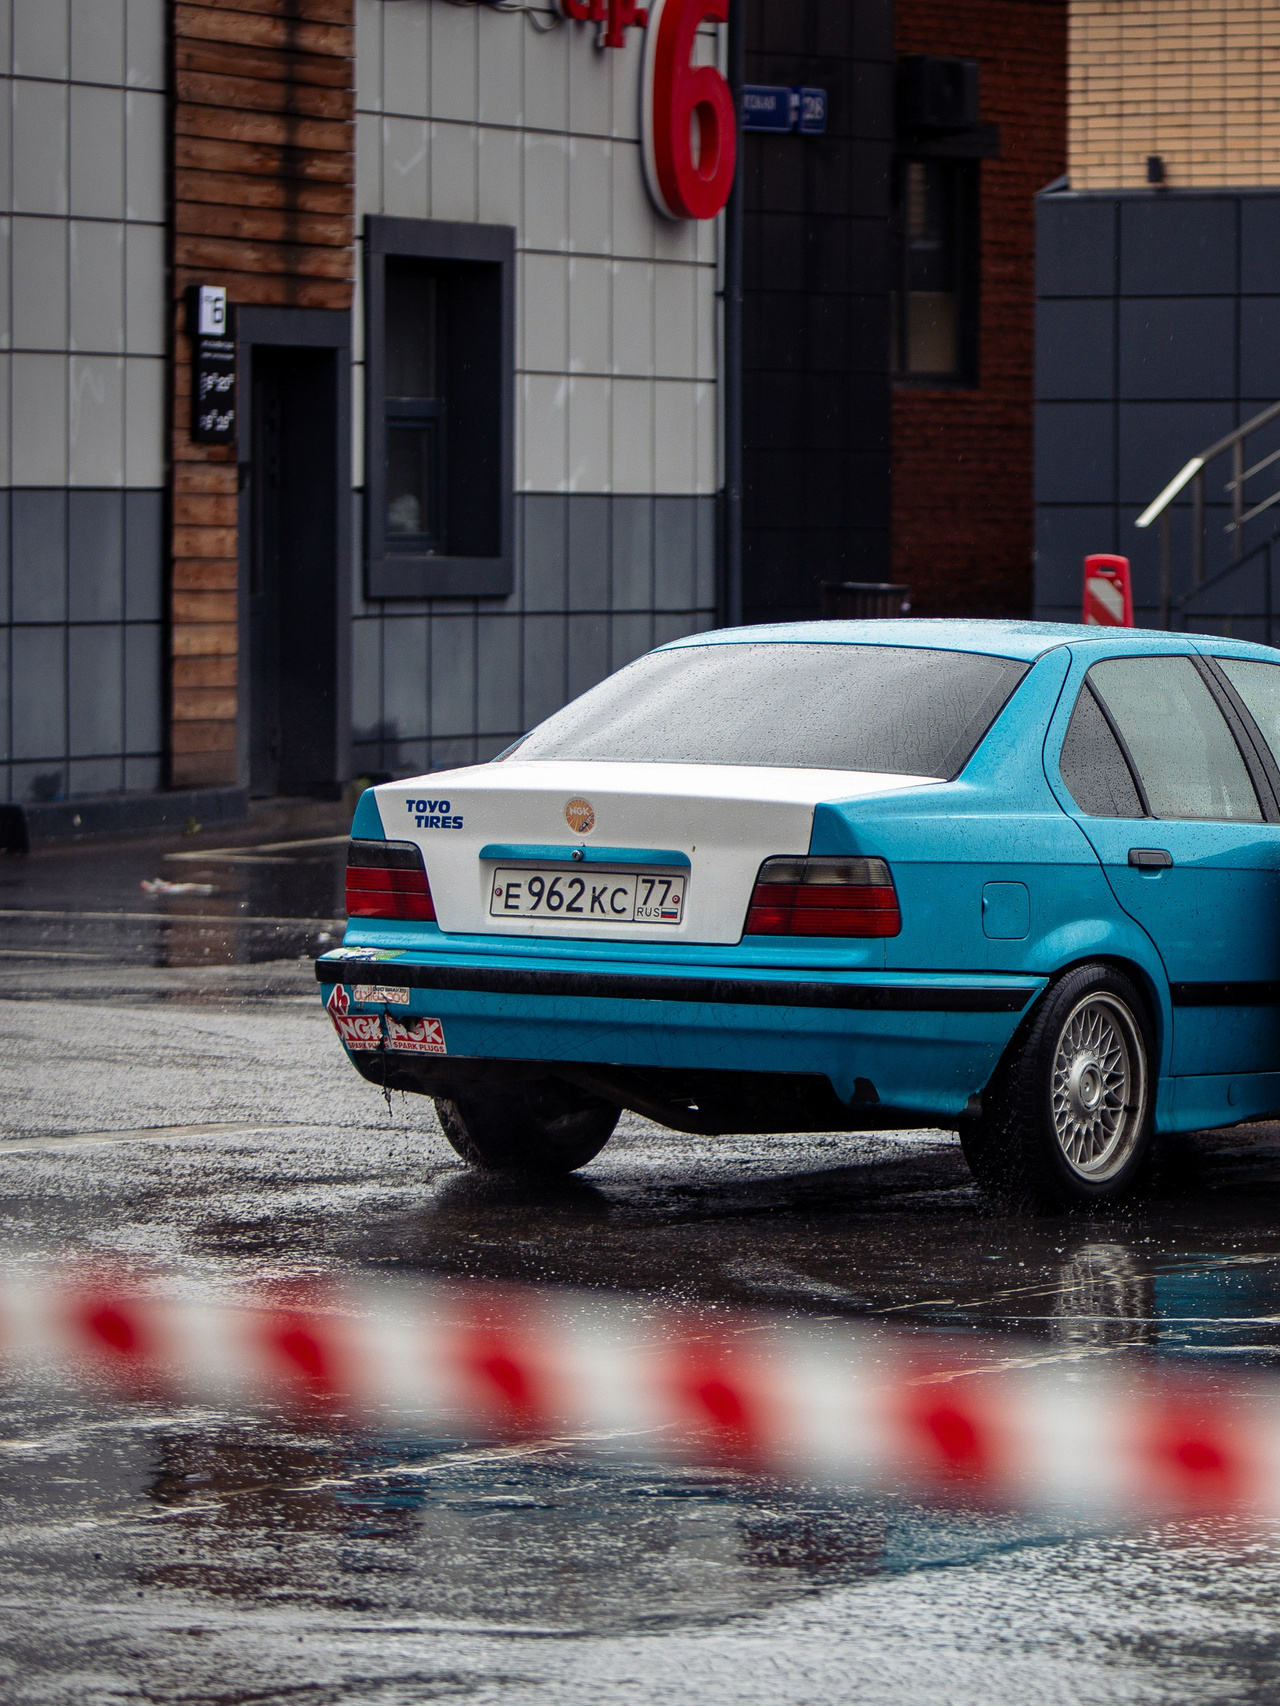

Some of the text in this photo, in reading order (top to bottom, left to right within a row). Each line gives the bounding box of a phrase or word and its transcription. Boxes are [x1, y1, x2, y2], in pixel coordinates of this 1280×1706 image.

[653, 0, 736, 220] 6
[406, 799, 451, 813] TOYO
[569, 806, 590, 817] NGK
[415, 815, 464, 829] TIRES
[641, 879, 672, 907] 77
[637, 907, 660, 917] RUS
[341, 1018, 382, 1040] NGK
[347, 1042, 367, 1050] SPARK
[393, 1041, 445, 1053] SPARK PLUGS
